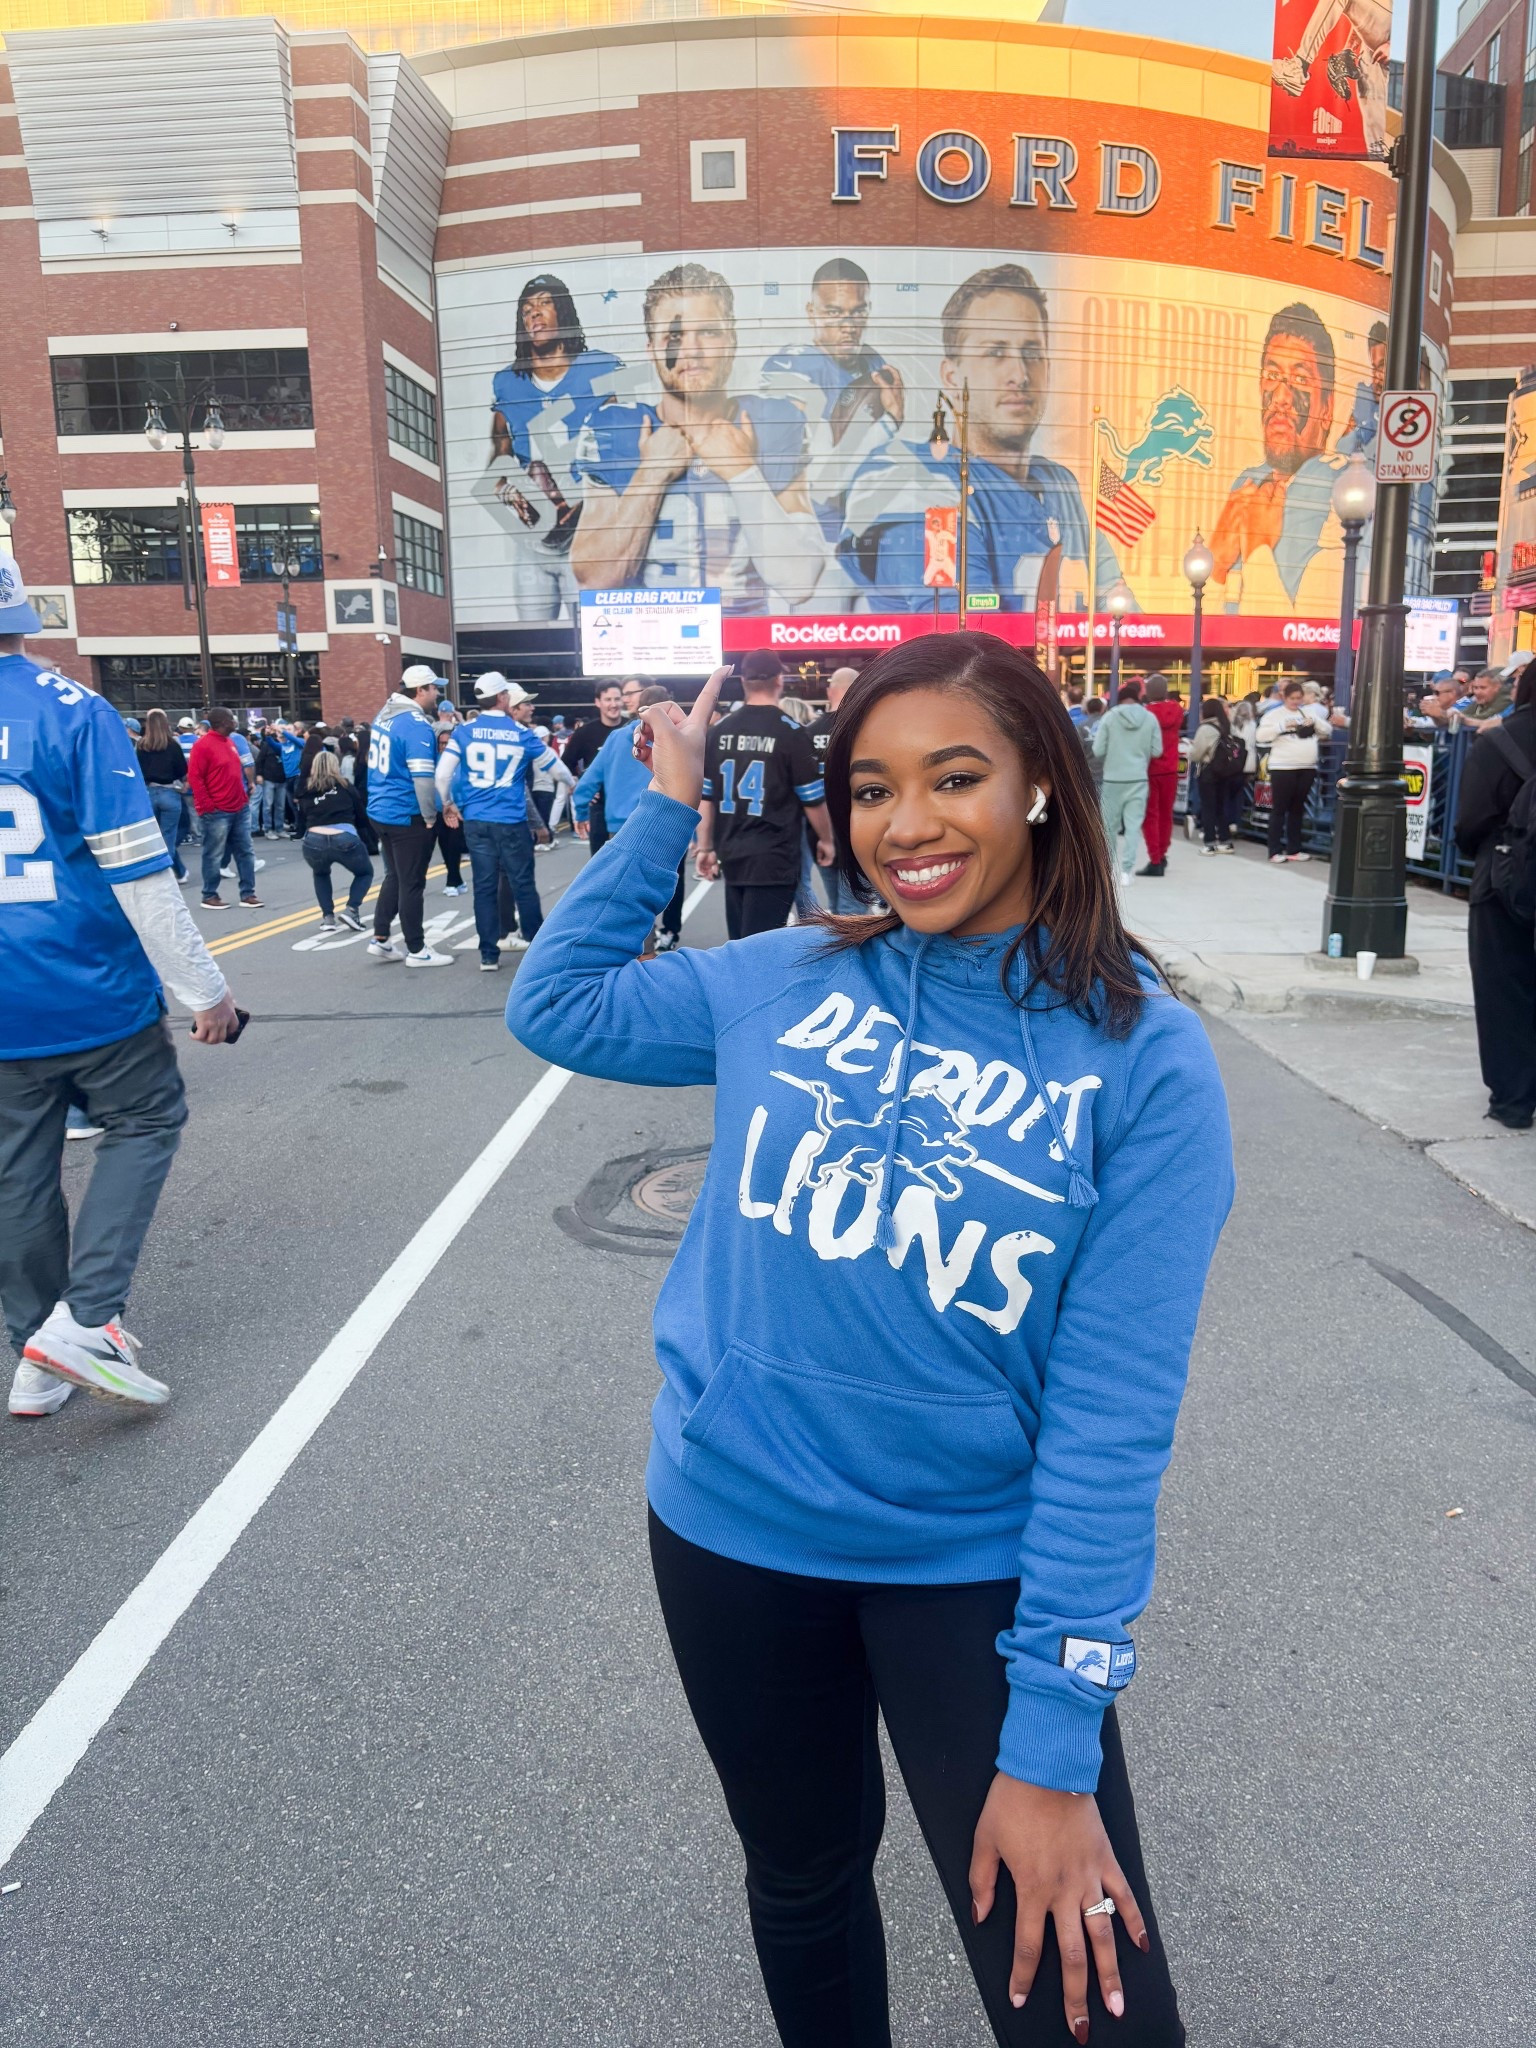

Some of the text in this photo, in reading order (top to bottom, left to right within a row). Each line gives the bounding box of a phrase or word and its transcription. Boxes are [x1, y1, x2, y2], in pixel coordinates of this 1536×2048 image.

[831, 124, 1396, 275] FORD FIEL
[1397, 450, 1413, 461] NO
[1379, 463, 1430, 477] STANDING
[208, 528, 233, 566] ENTRY
[595, 590, 706, 605] CLEAR BAG POLICY
[771, 622, 901, 644] Rocket.com
[1077, 620, 1107, 638] the
[1297, 622, 1341, 643] Rocke
[472, 727, 520, 743] HUTCHINSON
[719, 735, 776, 753] ST BROWN
[367, 729, 391, 775] 58
[466, 742, 525, 789] 97
[719, 759, 765, 817] 14
[776, 991, 1103, 1162] DETROIT
[738, 1105, 1056, 1335] LIONS
